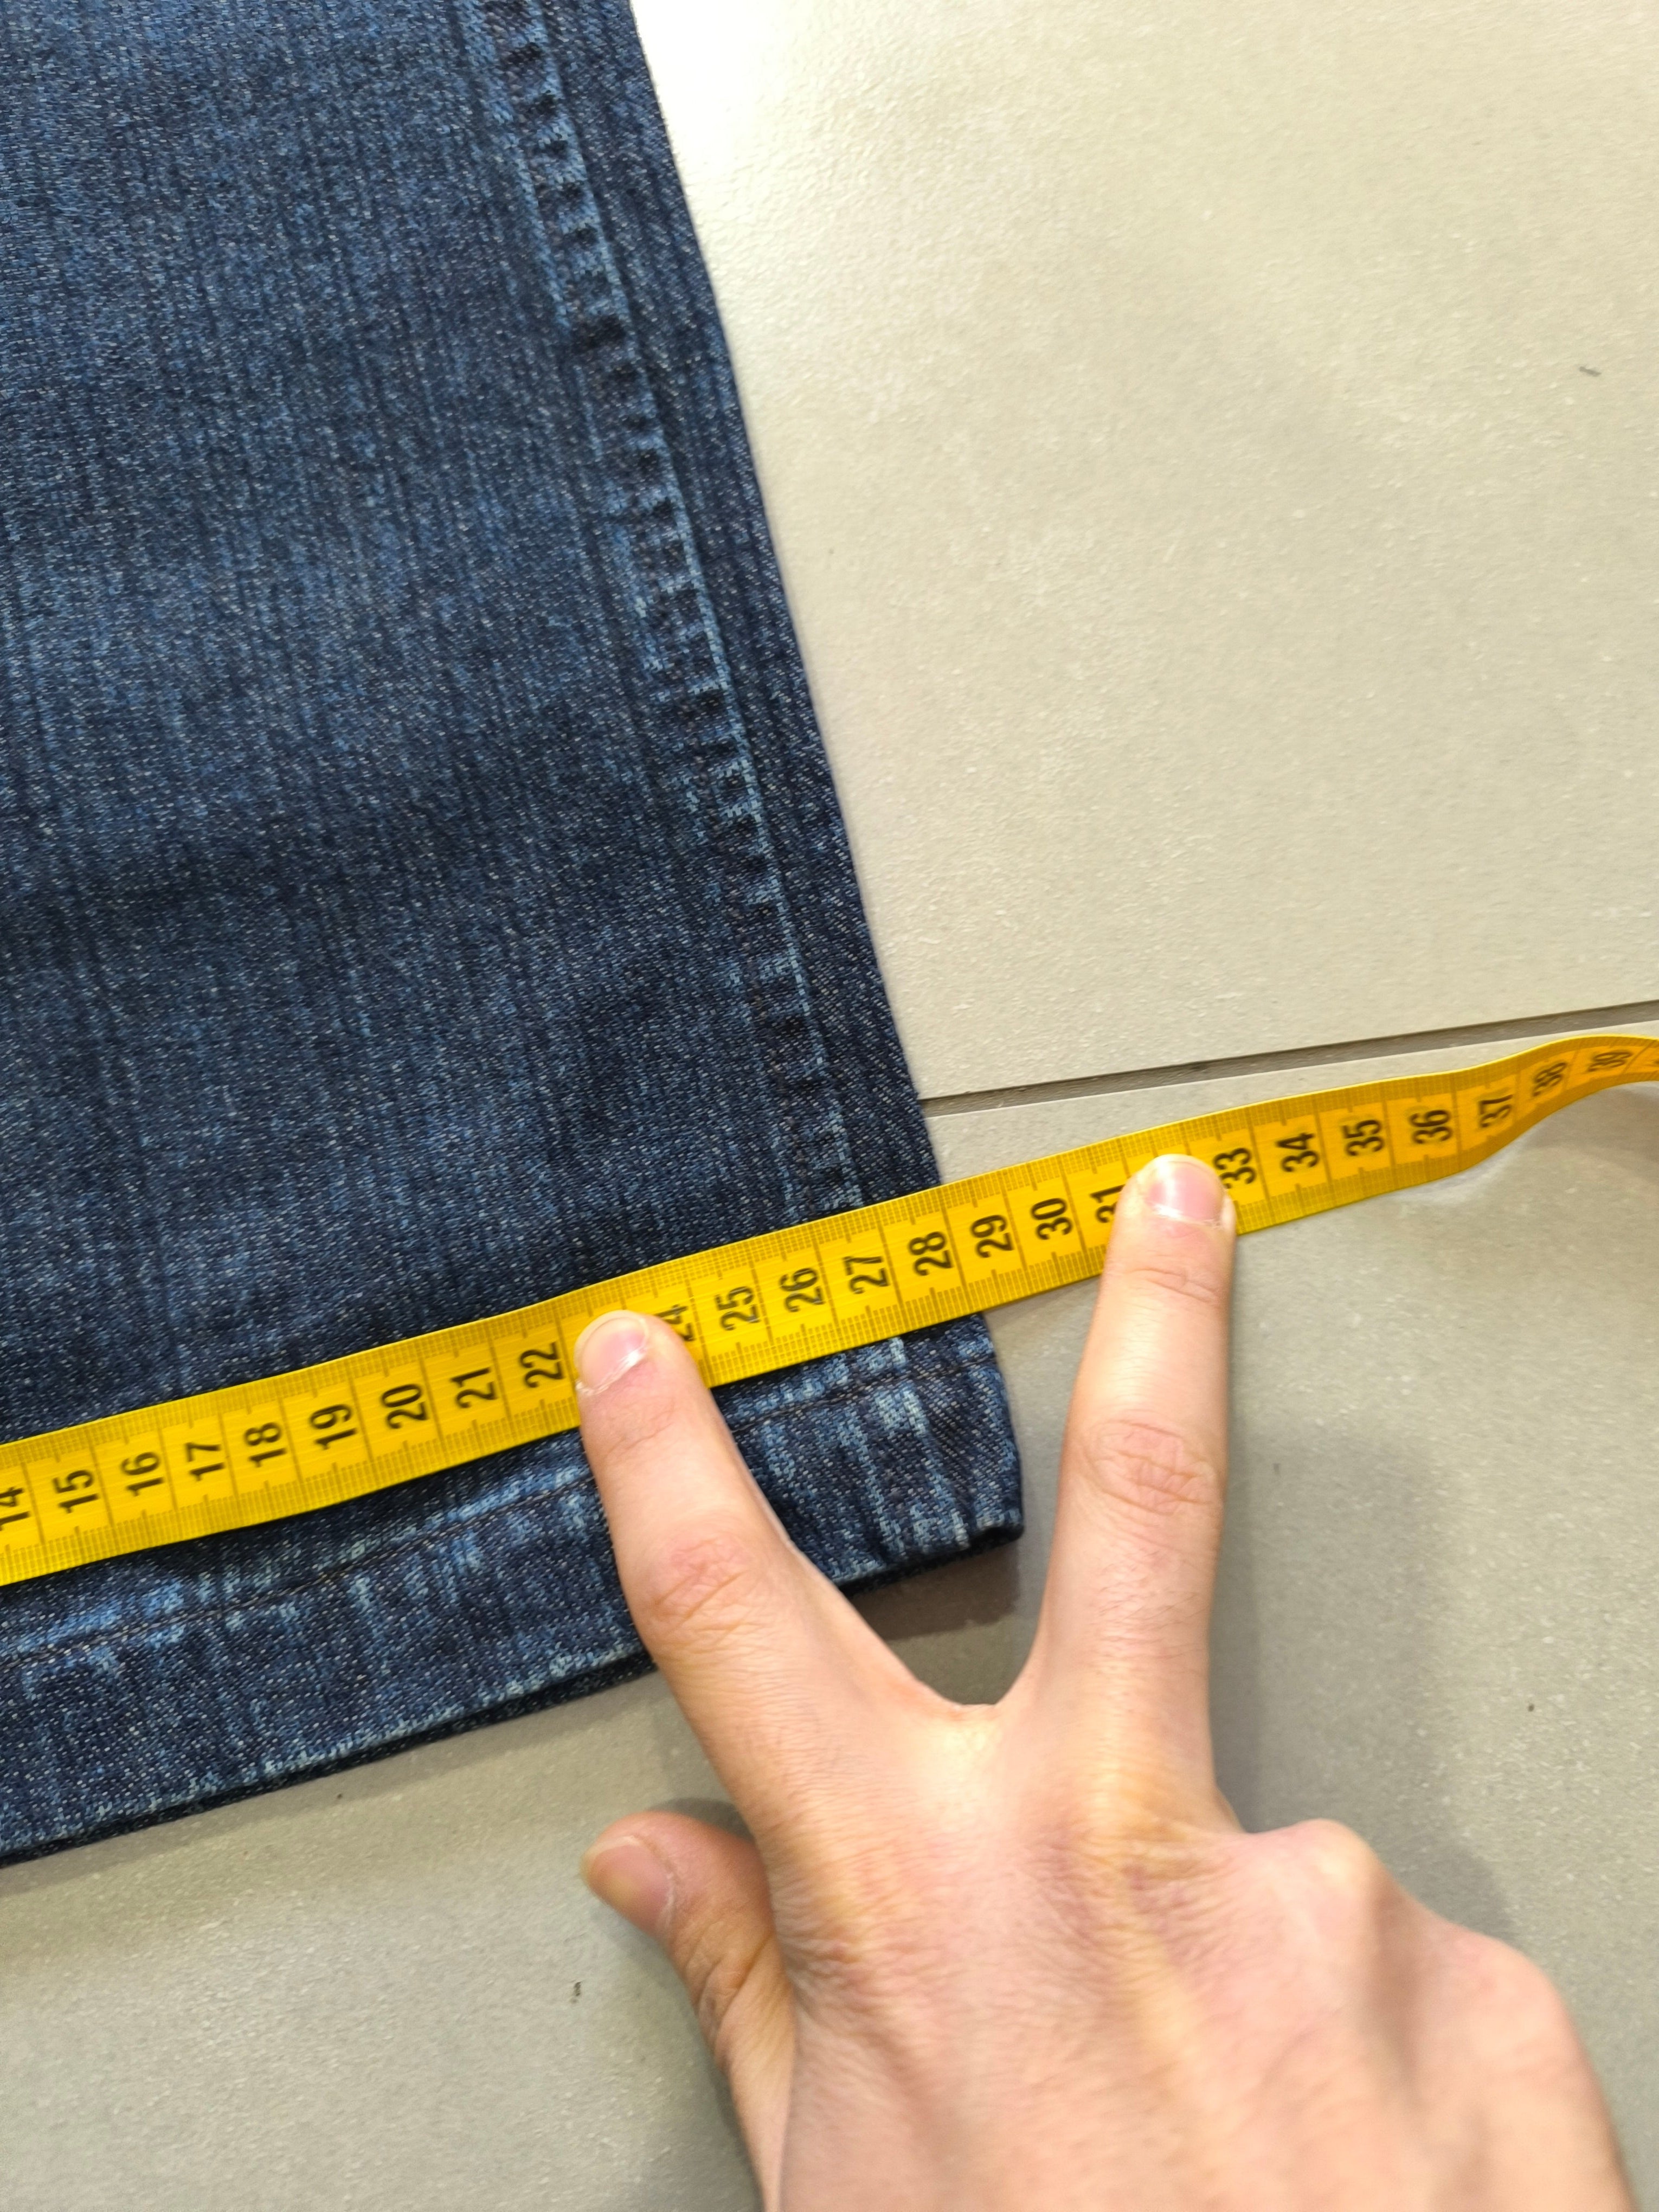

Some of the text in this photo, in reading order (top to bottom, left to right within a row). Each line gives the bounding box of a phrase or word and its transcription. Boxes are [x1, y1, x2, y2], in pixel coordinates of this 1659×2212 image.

[0, 1487, 30, 1531] 14
[53, 1470, 98, 1513] 15
[120, 1452, 164, 1496] 16
[185, 1442, 225, 1481] 17
[244, 1423, 287, 1467] 18
[309, 1404, 356, 1450] 19
[381, 1383, 429, 1429] 20
[450, 1367, 497, 1409] 21
[519, 1341, 565, 1388] 22
[715, 1285, 761, 1331] 25
[779, 1268, 824, 1313] 26
[843, 1256, 889, 1295] 27
[908, 1231, 953, 1276] 28
[970, 1214, 1014, 1258] 29
[1030, 1197, 1073, 1240] 30
[1212, 1147, 1257, 1189] 33
[1274, 1132, 1320, 1172] 34
[1341, 1118, 1385, 1158] 35
[1410, 1109, 1452, 1145] 36
[1478, 1094, 1514, 1129] 37
[1532, 1062, 1567, 1097] 38
[1587, 1051, 1633, 1072] 39
